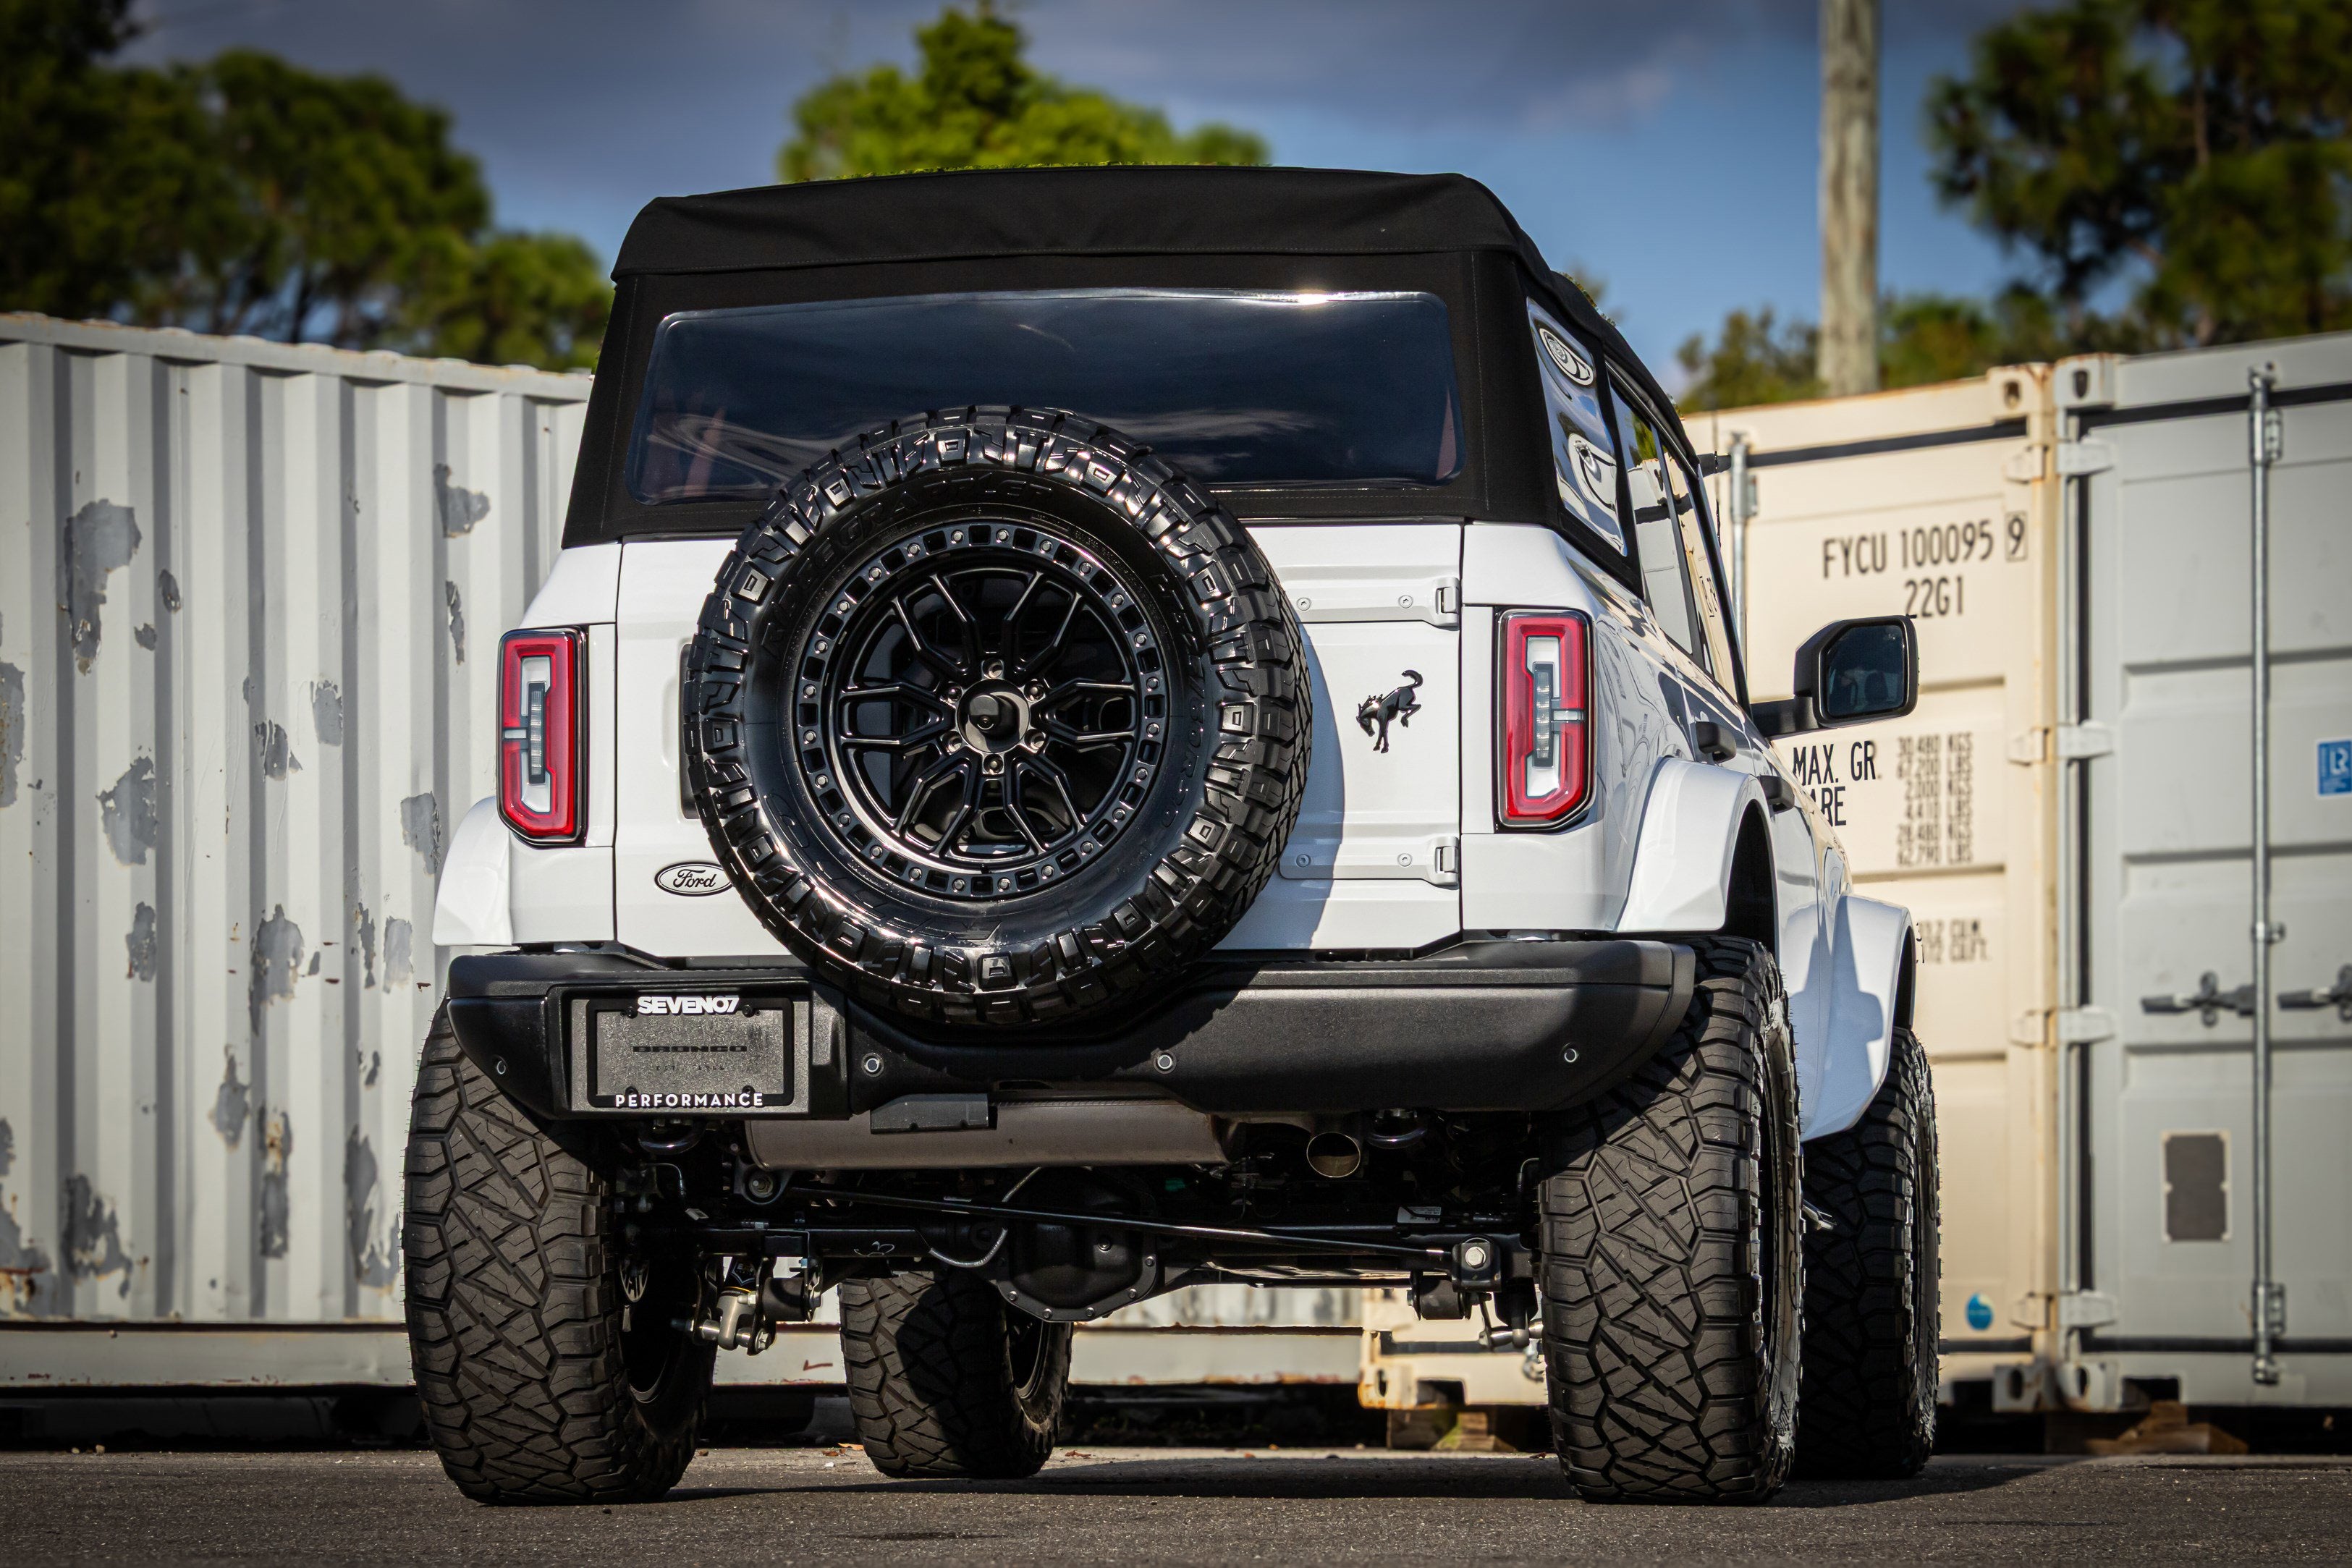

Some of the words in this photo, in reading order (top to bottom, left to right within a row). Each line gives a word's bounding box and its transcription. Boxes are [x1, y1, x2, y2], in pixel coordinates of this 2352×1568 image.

[1822, 532, 1887, 579] FYCU
[1900, 519, 1994, 569] 100095
[2007, 517, 2025, 556] 9
[1904, 576, 1963, 619] 22G1
[1793, 743, 1839, 787] MAX.
[1850, 739, 1882, 781] GR.
[1947, 731, 1973, 753] KGS
[1947, 754, 1973, 776] LBS
[1810, 786, 1847, 827] RE
[1947, 776, 1973, 797] KGS
[1947, 798, 1973, 820] LBS
[1947, 820, 1973, 842] KGS
[1947, 842, 1973, 864] LBS
[672, 868, 717, 889] Ford
[615, 1093, 763, 1108] PERFORMANCE
